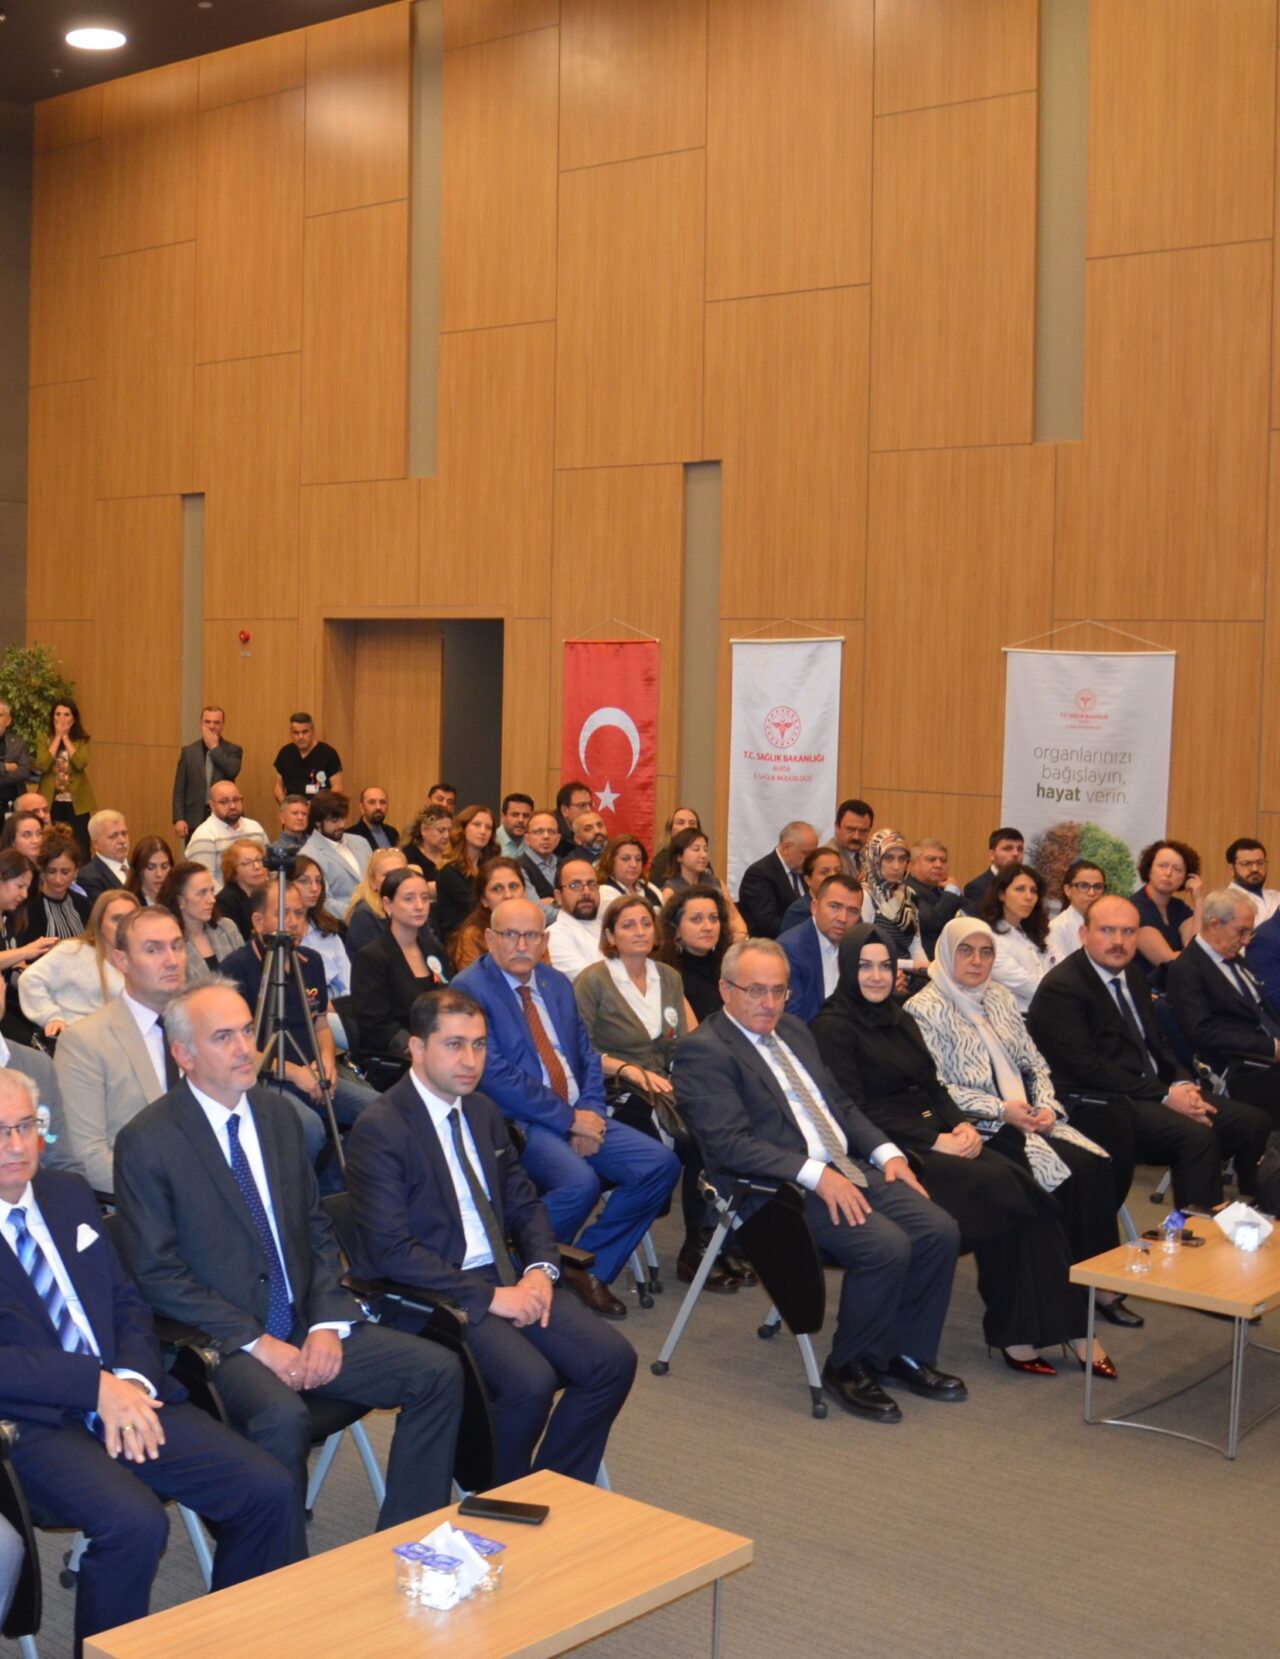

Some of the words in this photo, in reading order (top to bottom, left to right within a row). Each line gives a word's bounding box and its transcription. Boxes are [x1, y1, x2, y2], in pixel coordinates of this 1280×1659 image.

[756, 752, 782, 762] SAĞLIK
[783, 753, 825, 764] BAKANLIĞI
[1033, 746, 1132, 764] organlarınızı
[1041, 764, 1126, 786] bağışlayın,
[1036, 782, 1081, 802] hayat
[1086, 789, 1129, 805] verin.
